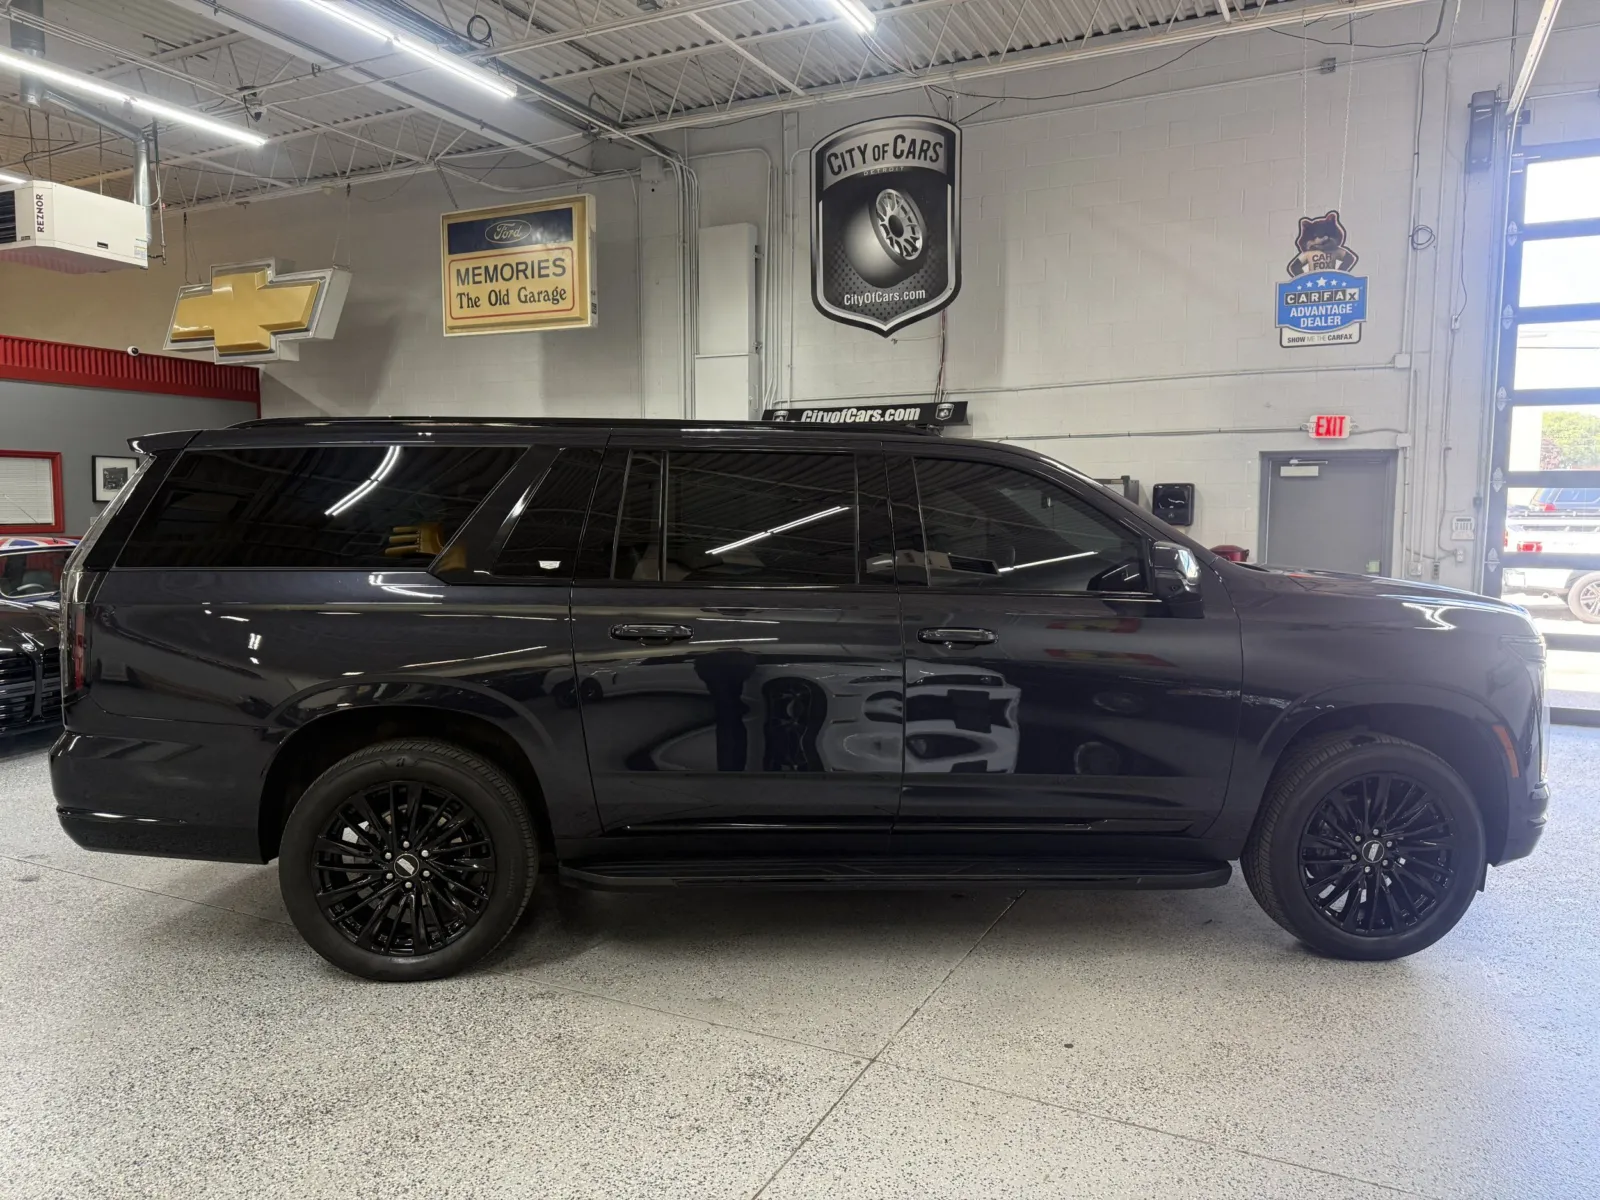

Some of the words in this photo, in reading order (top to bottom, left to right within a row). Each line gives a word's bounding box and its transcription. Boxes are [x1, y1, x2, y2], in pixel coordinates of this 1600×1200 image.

[827, 143, 868, 176] CITY
[872, 143, 890, 162] OF
[892, 134, 943, 163] CARS
[863, 166, 905, 176] DETROIT
[35, 193, 45, 233] REZNOR
[493, 223, 522, 240] Ford
[456, 257, 567, 287] MEMORIES
[456, 292, 481, 309] The
[488, 288, 510, 306] Old
[517, 286, 567, 305] Garage
[844, 289, 926, 306] CityOfCars.com
[1286, 291, 1357, 304] CARFAX
[1290, 304, 1353, 317] ADVANTAGE
[1300, 316, 1341, 328] DEALER
[1327, 333, 1353, 341] CARFAX
[801, 407, 921, 424] CityofCars.com
[1315, 416, 1346, 437] EXIT
